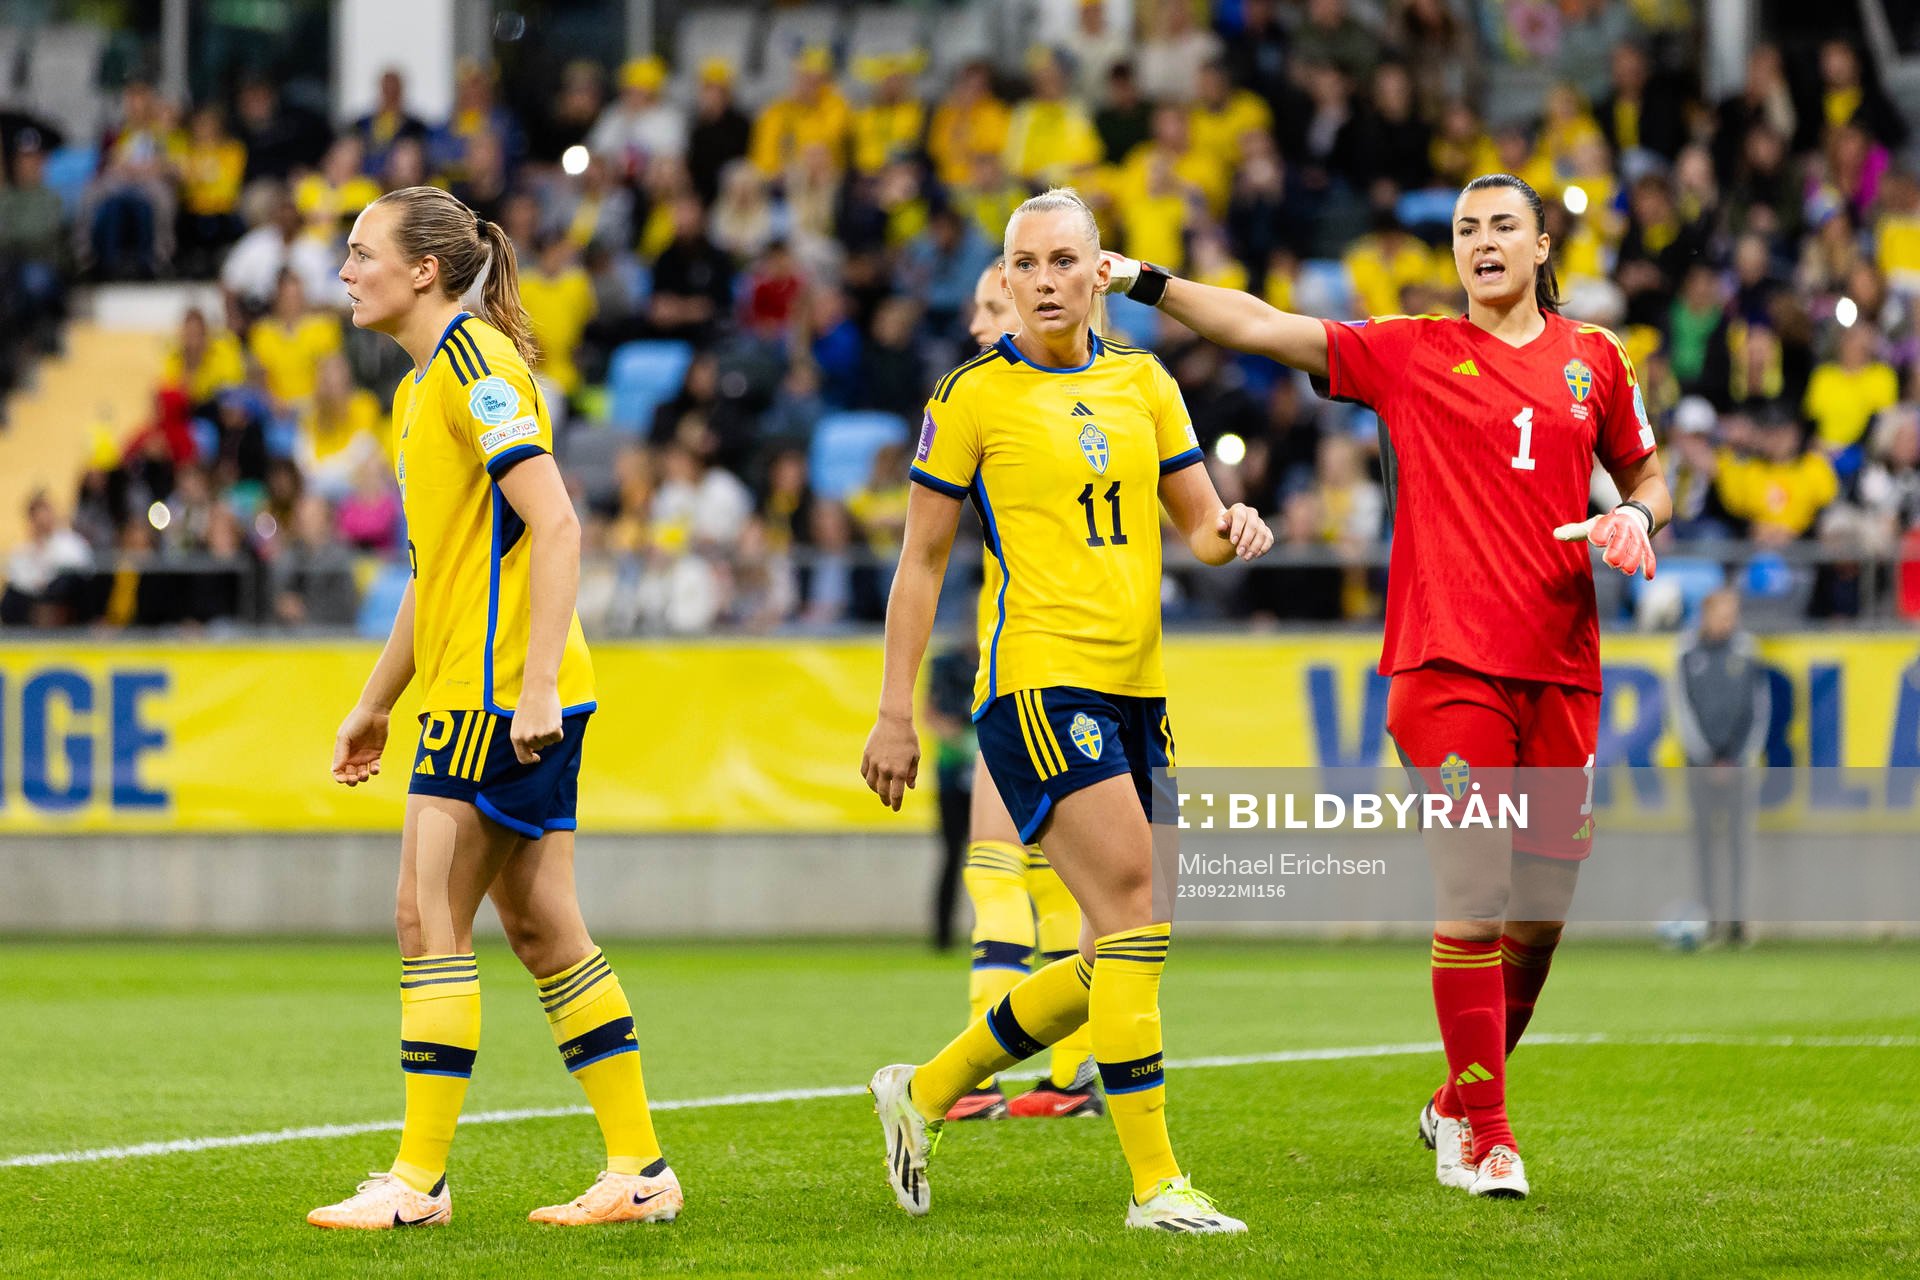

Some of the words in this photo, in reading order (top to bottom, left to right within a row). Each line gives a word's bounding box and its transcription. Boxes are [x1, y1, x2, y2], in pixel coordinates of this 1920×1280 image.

[482, 421, 537, 448] FOUNDATION
[1511, 407, 1536, 471] 1
[1077, 481, 1128, 547] 11
[0, 671, 168, 813] GE
[1304, 665, 1663, 809] VR
[1580, 753, 1595, 815] 1
